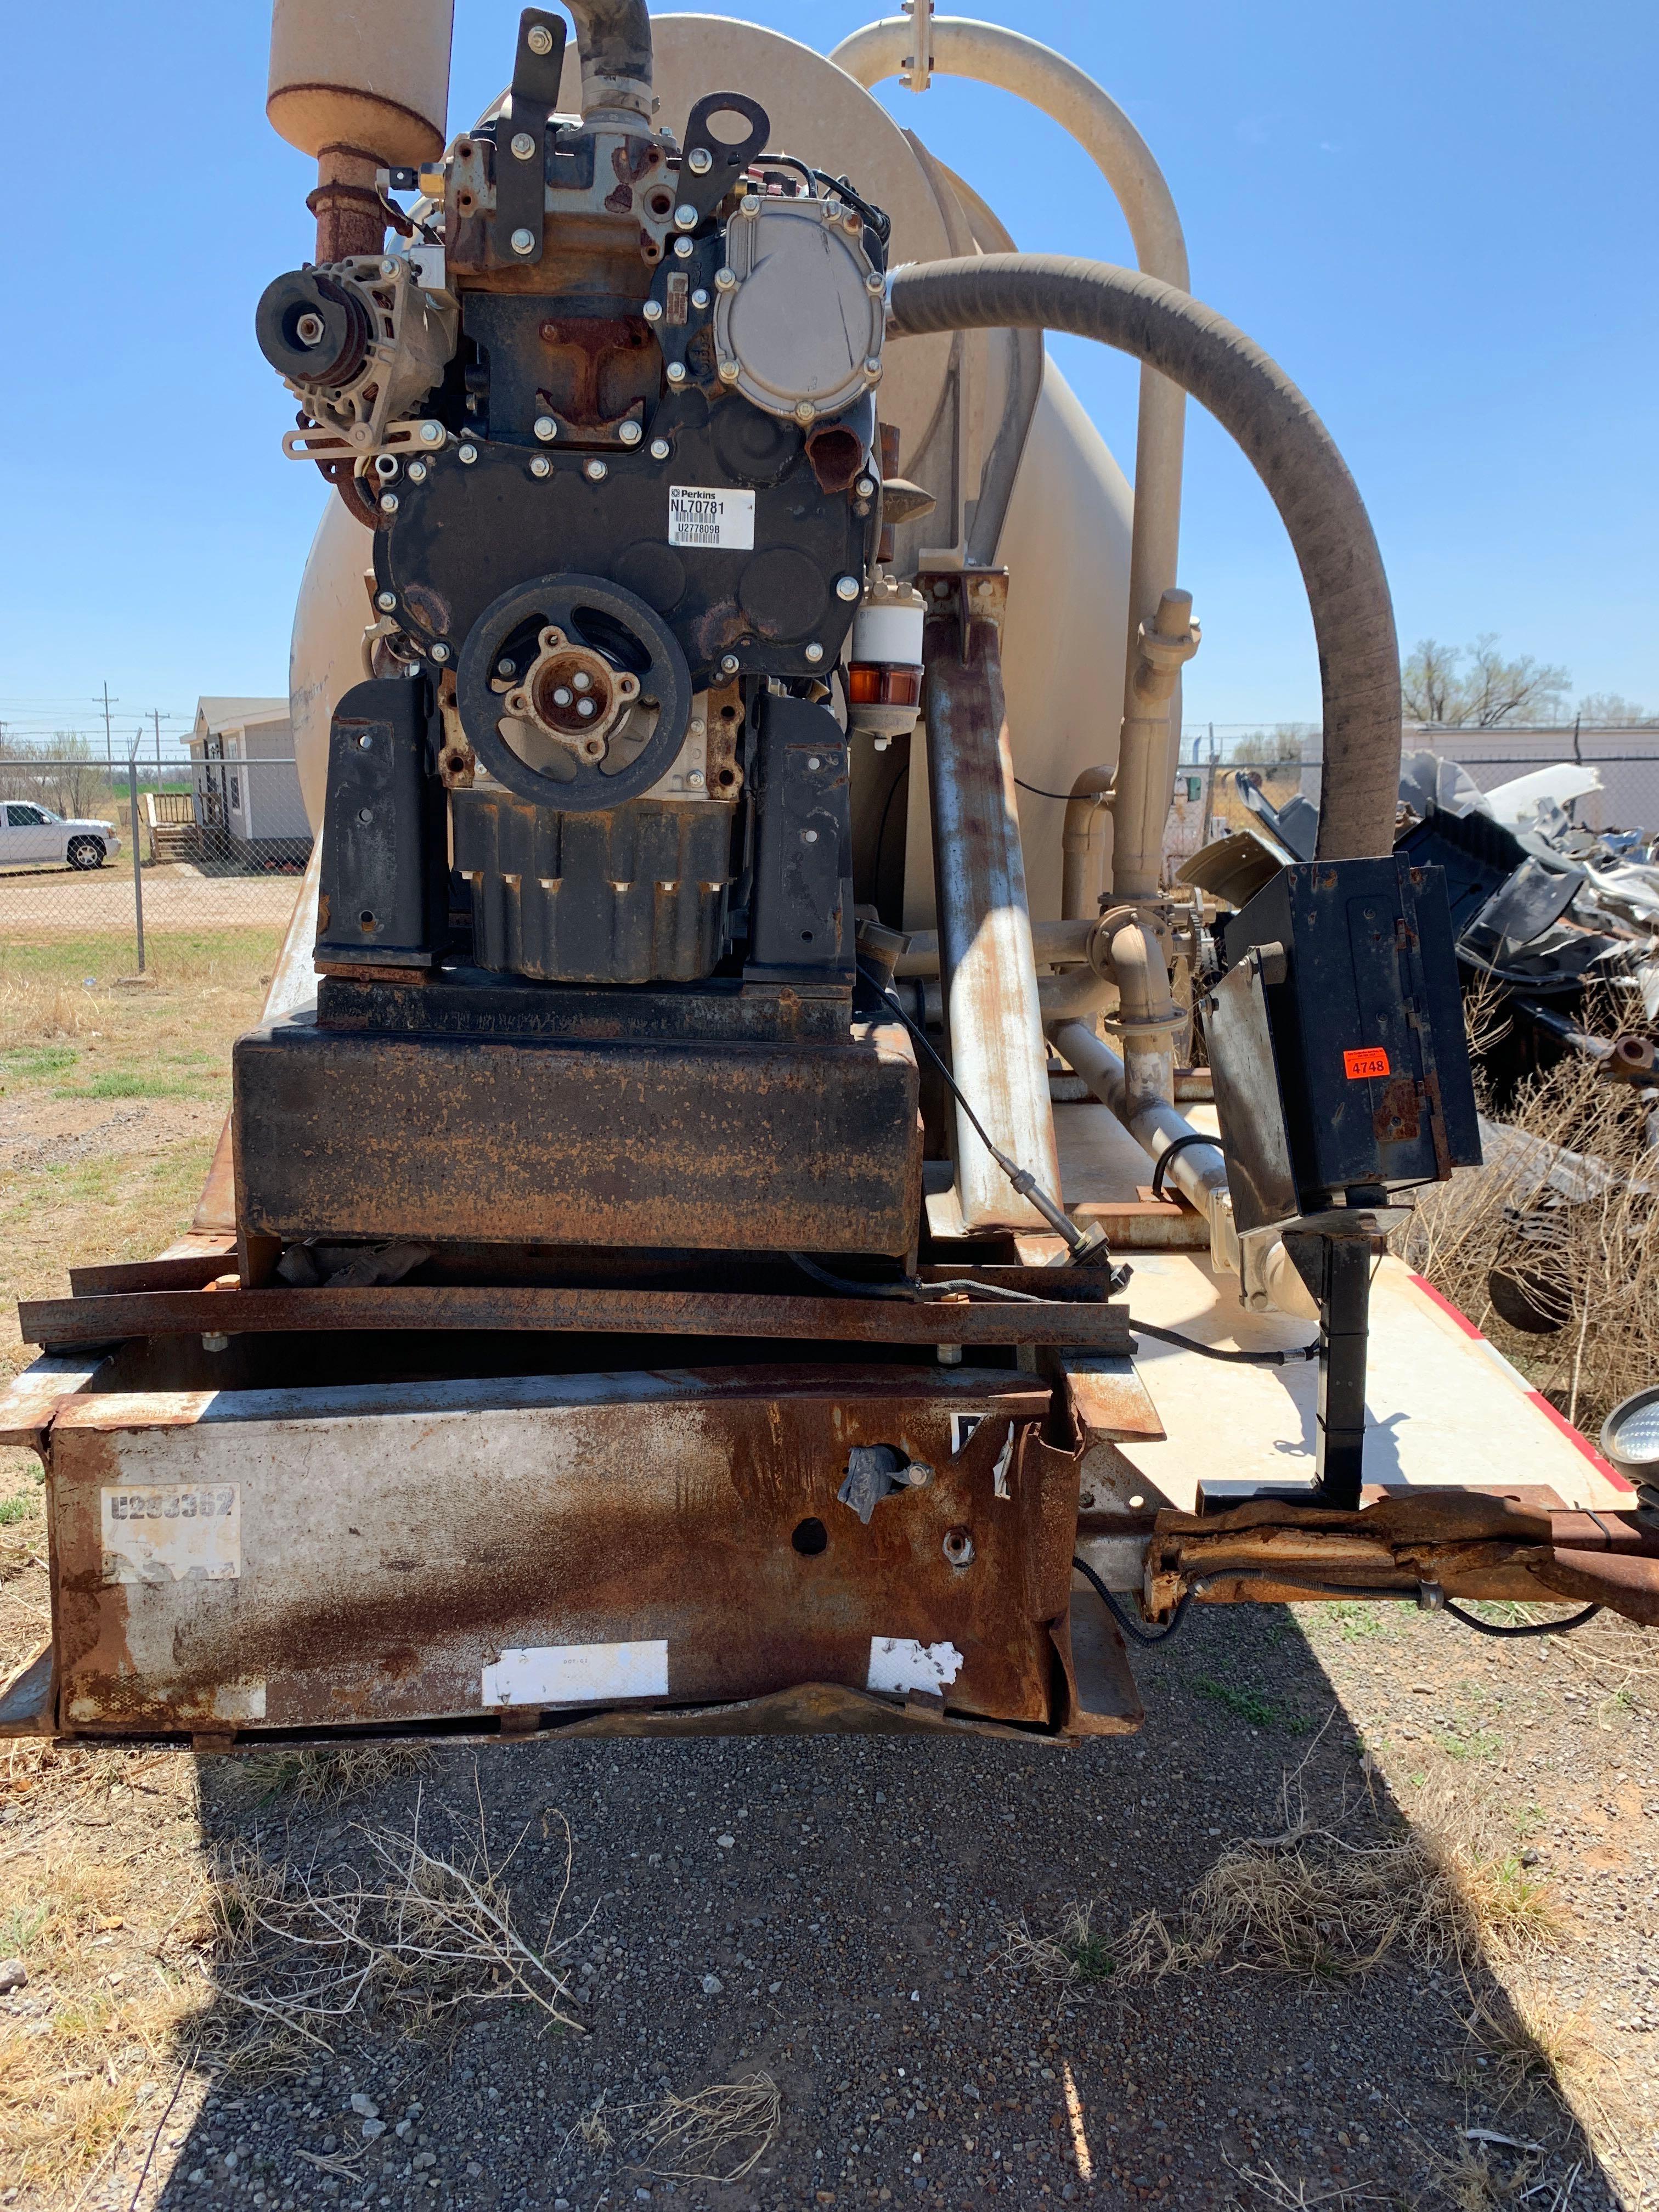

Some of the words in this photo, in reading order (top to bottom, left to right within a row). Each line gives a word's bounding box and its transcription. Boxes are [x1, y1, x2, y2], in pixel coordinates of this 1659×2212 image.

[681, 490, 715, 499] Perkins
[671, 499, 724, 514] NL70781
[678, 523, 720, 534] U277809B
[1353, 1060, 1384, 1074] 4748
